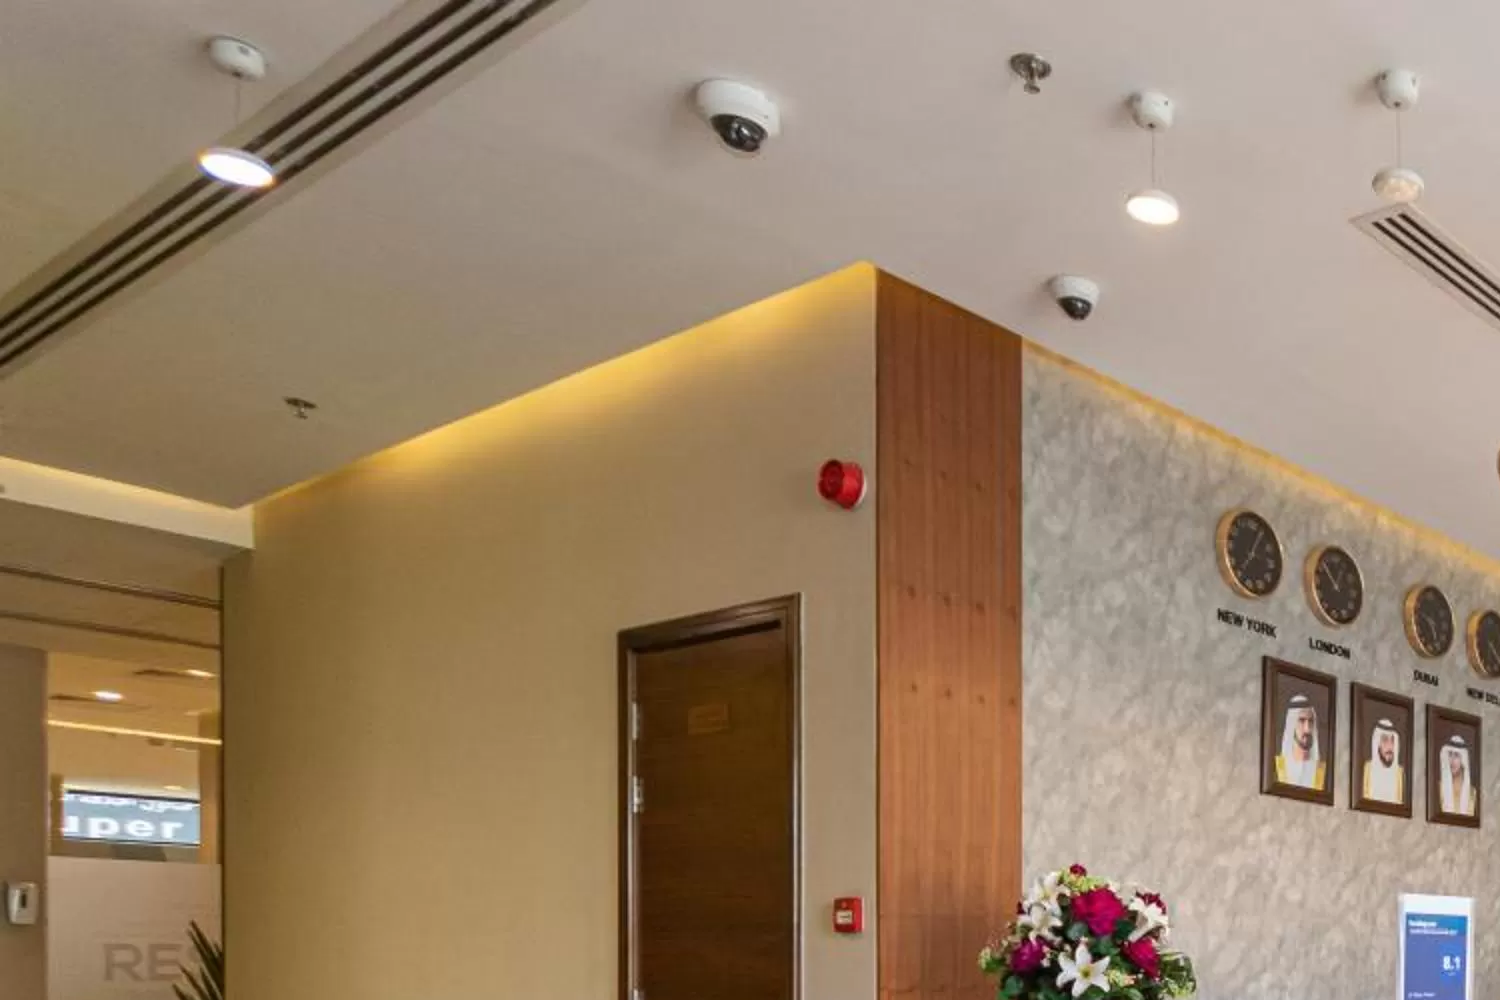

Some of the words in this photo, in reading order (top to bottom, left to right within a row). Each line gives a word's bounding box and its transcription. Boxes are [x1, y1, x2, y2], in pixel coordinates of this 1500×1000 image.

[1217, 607, 1244, 627] NEW
[1246, 616, 1277, 639] YORK
[1308, 637, 1351, 660] LONDON
